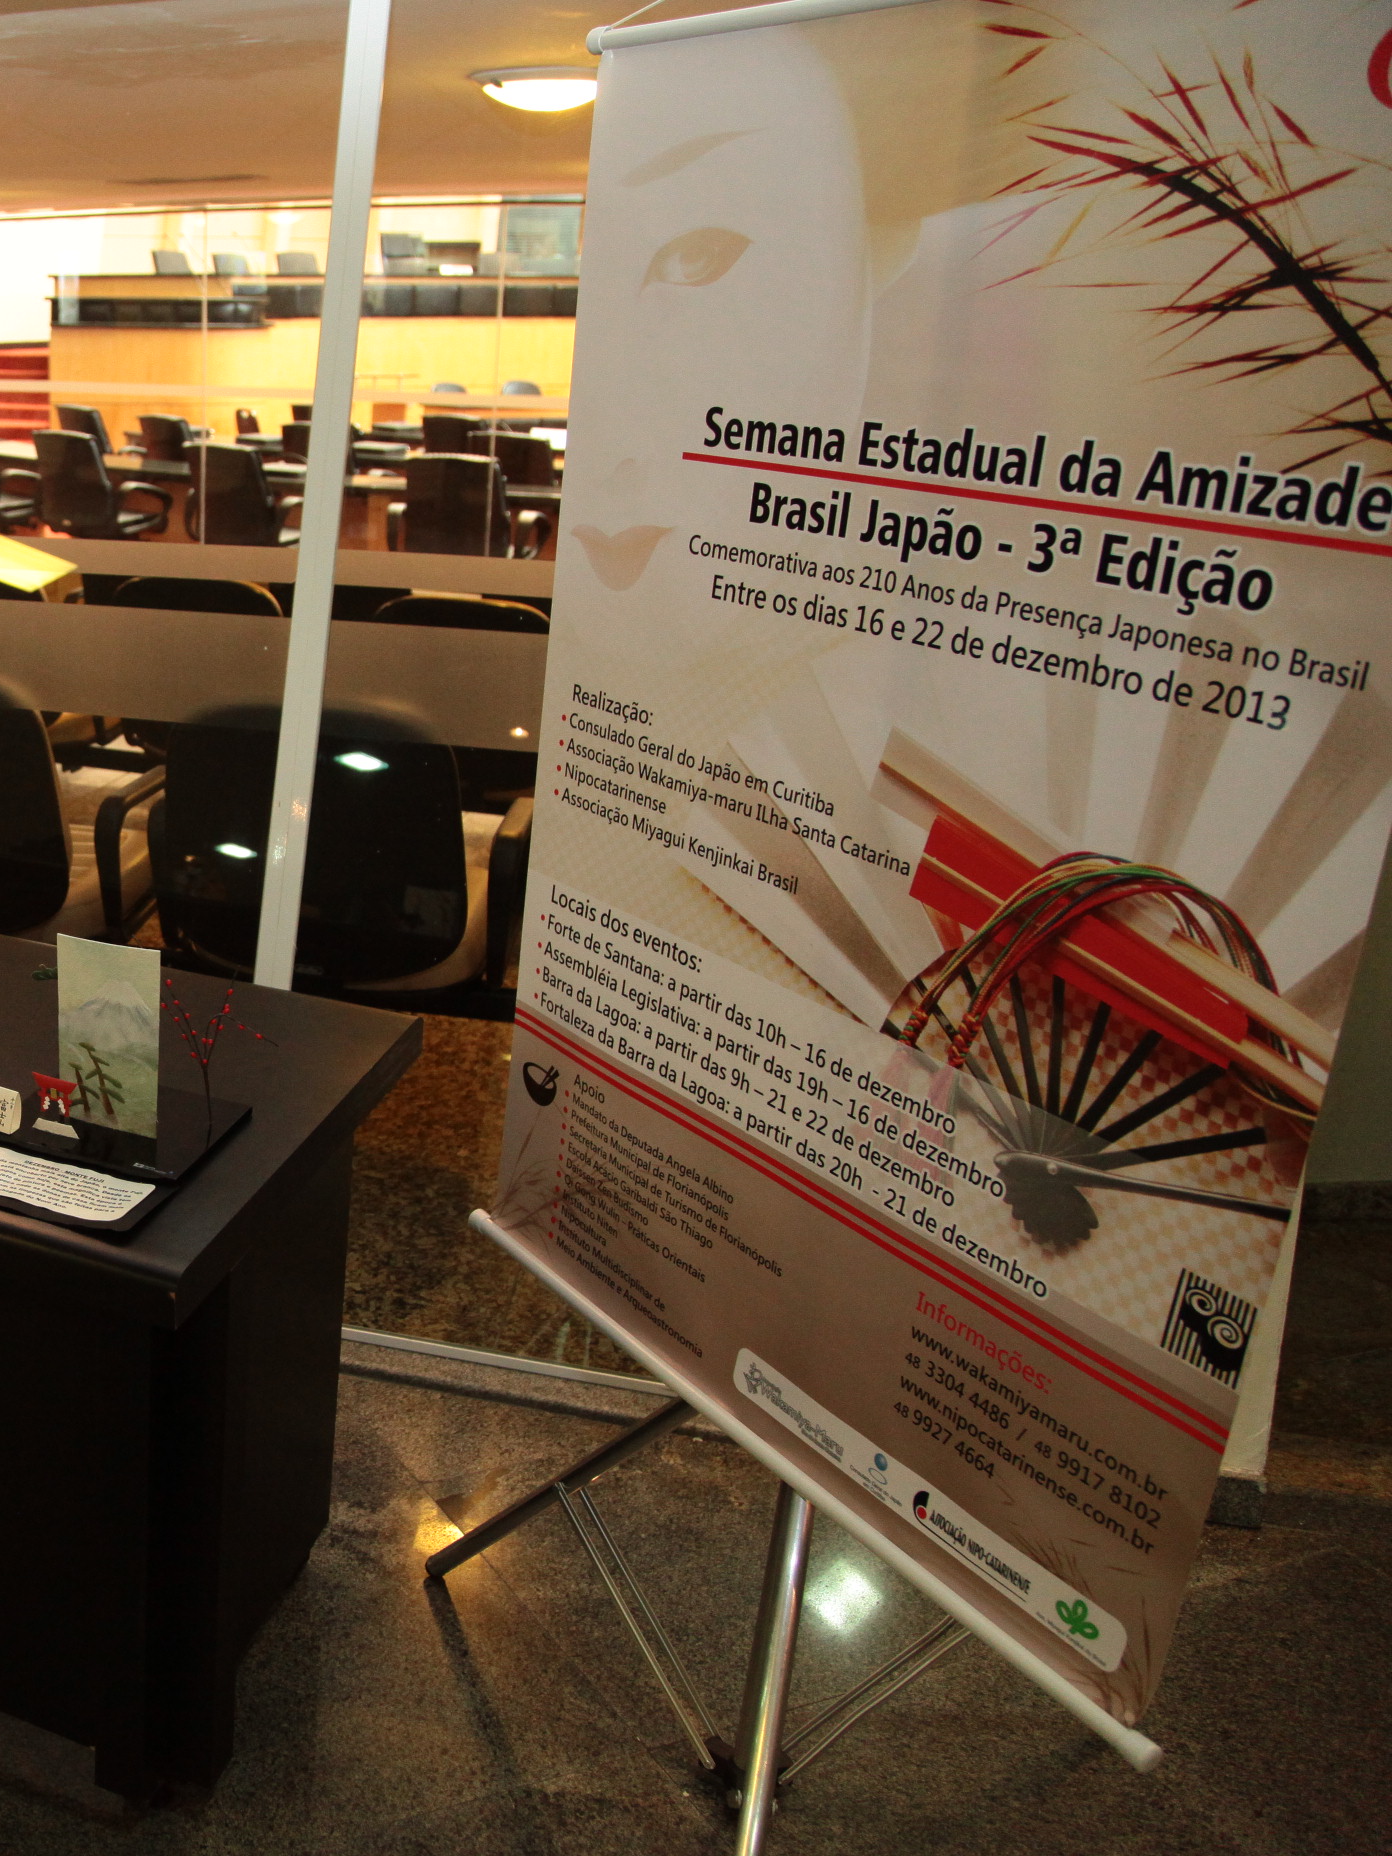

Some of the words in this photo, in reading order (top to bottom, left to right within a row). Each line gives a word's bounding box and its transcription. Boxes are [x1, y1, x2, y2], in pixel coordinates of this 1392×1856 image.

[704, 406, 845, 462] Semana
[858, 422, 1046, 487] Estadual
[1060, 440, 1121, 497] da
[1136, 451, 1392, 532] Amizade
[689, 534, 817, 578] Comemorativa
[822, 564, 855, 586] aos
[859, 566, 897, 594] 210
[900, 574, 955, 606] Anos
[961, 585, 988, 612] da
[995, 591, 1102, 639] Presença
[1108, 614, 1233, 662] Japonesa
[1242, 646, 1280, 671] no
[1289, 648, 1370, 691] Brasil
[749, 482, 852, 538] Brasil
[859, 499, 982, 563] Japão
[1027, 523, 1082, 573] 3ª
[1096, 534, 1273, 615] Edição
[572, 684, 653, 726] Realização:
[711, 574, 767, 609] Entre
[772, 594, 798, 616] os
[803, 594, 848, 628] dias
[854, 605, 884, 636] 16
[891, 620, 905, 641] e
[911, 617, 944, 650] 22
[951, 626, 984, 659] de
[992, 635, 1143, 695] dezembro
[1152, 670, 1193, 707] de
[1202, 681, 1291, 730] 2013
[565, 762, 666, 814] Nipocatarinense
[566, 738, 635, 775] Associação
[638, 761, 752, 818] Wakamiya-maru
[792, 817, 836, 849] Santa
[840, 835, 910, 876] Catarina
[569, 712, 635, 748] Consulado
[638, 735, 674, 761] Geral
[677, 748, 695, 768] do
[698, 755, 741, 784] Japão
[744, 775, 768, 794] em
[773, 780, 834, 817] Curitiba
[561, 787, 629, 826] Associação
[632, 814, 685, 849] Miyagui
[688, 836, 754, 876] Kenjinkai
[757, 863, 798, 895] Brasil
[551, 884, 597, 922] Locais
[600, 909, 629, 937] dos
[633, 928, 702, 973] eventos:
[542, 966, 573, 997] Barra
[576, 987, 592, 1008] da
[596, 995, 641, 1034] Lagoa:
[644, 1026, 653, 1040] a
[655, 1032, 698, 1063] partir
[700, 1053, 727, 1080] das
[730, 1068, 750, 1094] 9h
[767, 1088, 786, 1115] 21
[792, 1107, 802, 1122] e
[805, 1109, 828, 1136] 22
[832, 1126, 854, 1151] de
[858, 1141, 954, 1207] dezembro
[544, 941, 618, 992] Assembléia
[621, 979, 700, 1035] Legislativa:
[703, 1027, 712, 1042] a
[715, 1033, 760, 1065] partir
[763, 1055, 792, 1084] das
[796, 1071, 828, 1103] 19h
[847, 1099, 870, 1125] 16
[874, 1114, 898, 1140] de
[902, 1130, 1003, 1197] dezembro
[547, 914, 581, 944] Forte
[584, 933, 601, 954] de
[604, 942, 664, 986] Santana:
[667, 977, 676, 992] a
[679, 983, 722, 1014] partir
[725, 1003, 752, 1031] das
[756, 1018, 786, 1049] 10h
[805, 1043, 826, 1068] 16
[830, 1057, 853, 1083] de
[857, 1071, 955, 1134] dezembro
[540, 991, 595, 1038] Fortaleza
[598, 1027, 614, 1049] da
[618, 1036, 655, 1071] Barra
[658, 1061, 677, 1084] da
[681, 1071, 730, 1114] Lagoa:
[733, 1106, 742, 1121] a
[746, 1113, 793, 1148] partir
[796, 1139, 826, 1168] das
[829, 1156, 862, 1190] 20h
[884, 1188, 906, 1217] 21
[912, 1207, 937, 1234] de
[942, 1224, 1047, 1298] dezembro
[572, 1093, 607, 1125] Mandato
[608, 1119, 619, 1133] da
[620, 1125, 664, 1162] Deputada
[665, 1155, 701, 1183] Angela
[702, 1176, 734, 1204] Albino
[573, 1074, 605, 1104] Apoio
[568, 1141, 592, 1167] Escola
[592, 1160, 619, 1186] Acácio
[620, 1180, 658, 1214] Garibaldi
[659, 1207, 678, 1226] São
[680, 1218, 713, 1249] Thiago
[569, 1125, 607, 1160] Secretaria
[608, 1153, 649, 1190] Municipal
[650, 1183, 662, 1199] de
[665, 1190, 703, 1223] Turismo
[705, 1217, 718, 1233] de
[719, 1225, 782, 1277] Florianópolis
[571, 1109, 609, 1144] Prefeitura
[610, 1136, 651, 1174] Municipal
[652, 1165, 665, 1181] de
[666, 1173, 729, 1221] Florianópolis
[915, 1291, 1052, 1394] Informações:
[893, 1401, 909, 1418] 48
[912, 1409, 953, 1445] 9927
[954, 1441, 995, 1479] 4664
[900, 1375, 1154, 1554] www.nipocatarinense.com.br
[905, 1352, 921, 1369] 48
[925, 1360, 965, 1399] 3304
[968, 1392, 1010, 1430] 4486
[1034, 1441, 1052, 1459] 48
[1056, 1451, 1105, 1490] 9917
[1109, 1485, 1161, 1529] 8102
[911, 1325, 1168, 1501] www.wakamiyamaru.com.br
